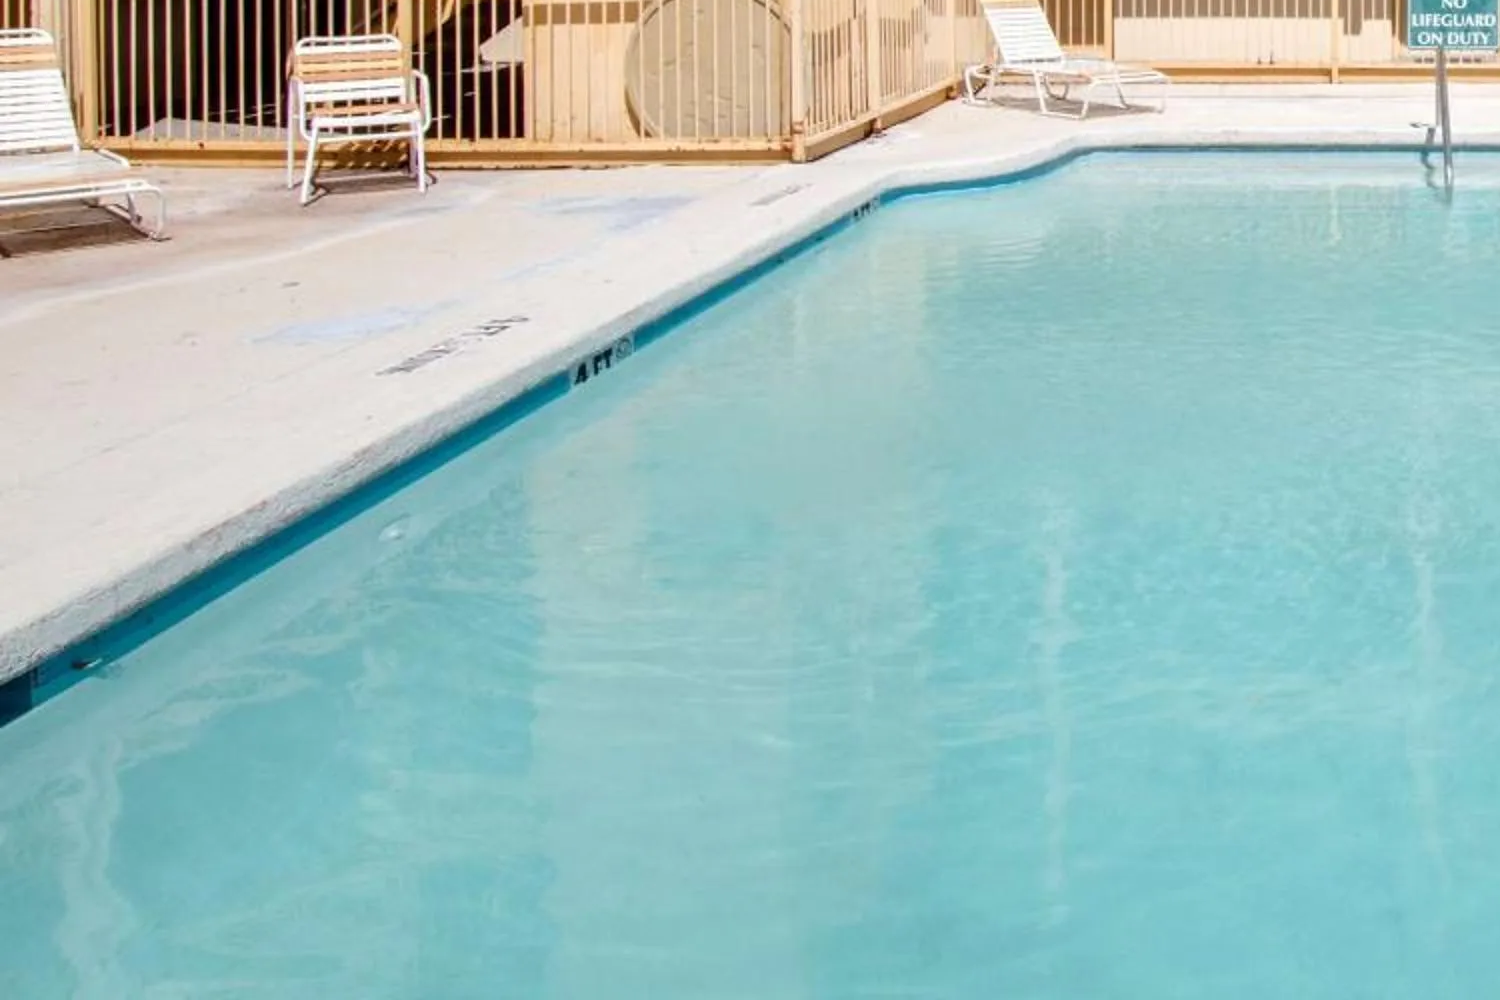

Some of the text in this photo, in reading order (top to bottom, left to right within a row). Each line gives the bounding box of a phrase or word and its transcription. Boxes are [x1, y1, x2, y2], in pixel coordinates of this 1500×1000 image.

[1411, 13, 1497, 27] LIFEGUARD
[1417, 31, 1490, 45] ON DUTY
[574, 347, 614, 386] 4 FT
